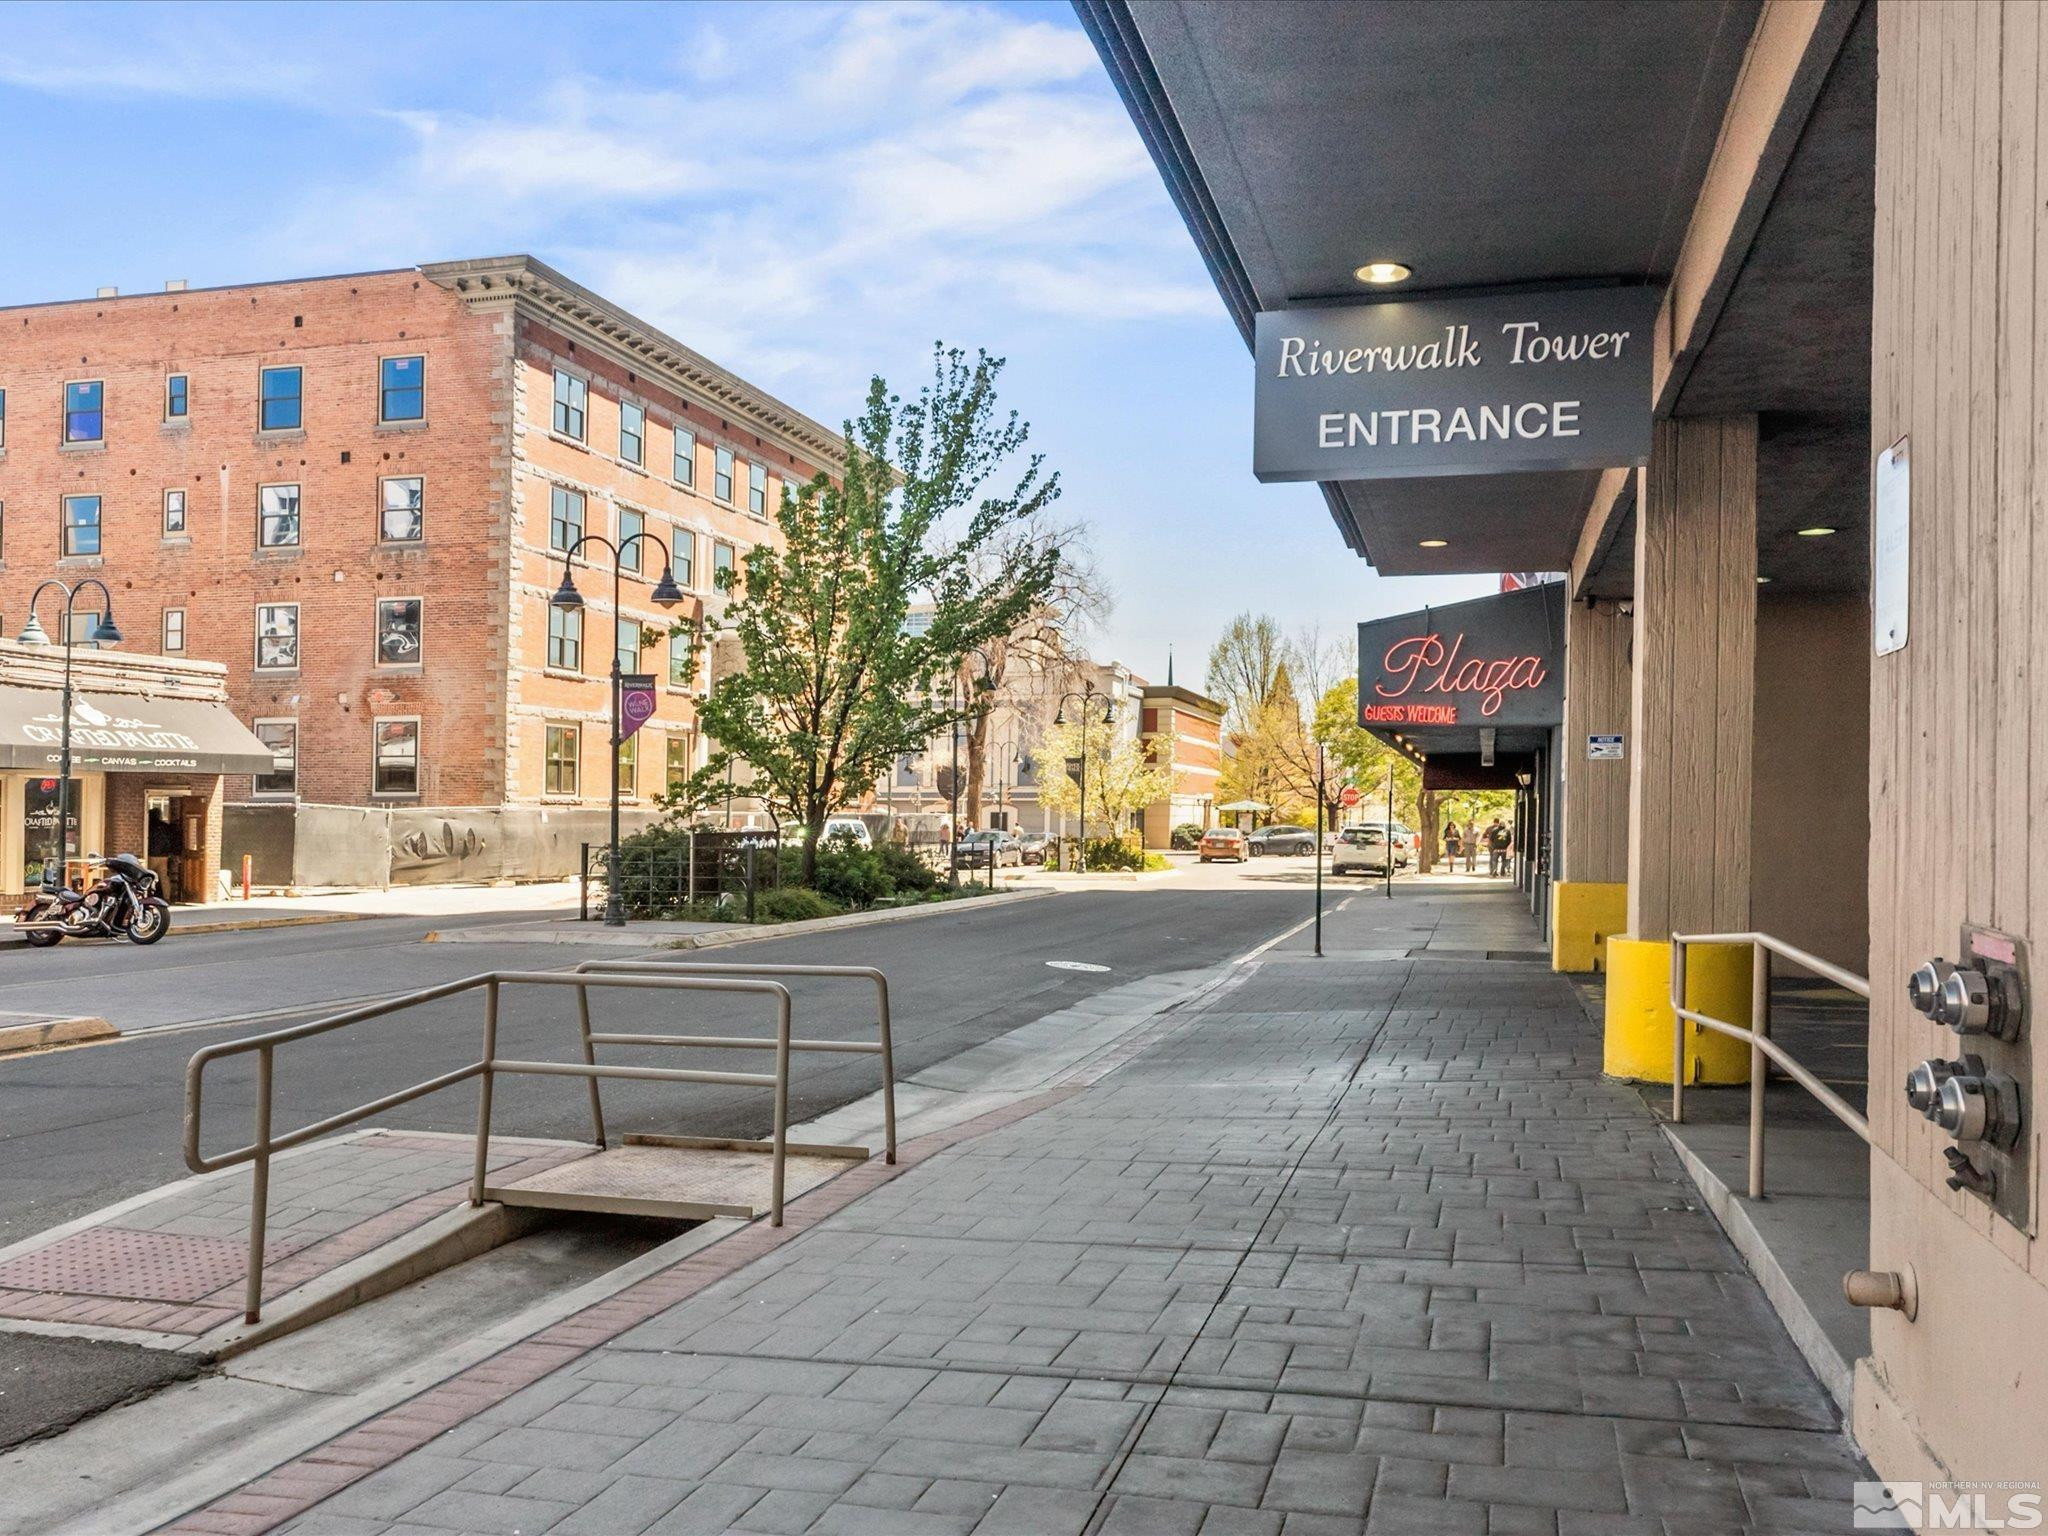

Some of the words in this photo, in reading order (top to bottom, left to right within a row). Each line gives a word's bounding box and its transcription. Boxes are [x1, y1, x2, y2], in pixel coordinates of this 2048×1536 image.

[1277, 325, 1481, 378] Riverwalk
[1502, 322, 1631, 365] Tower
[1319, 401, 1581, 448] ENTRANCE
[1375, 633, 1547, 716] Plaza
[1365, 705, 1404, 721] GUESTS
[1407, 705, 1456, 724] WELCOME
[47, 754, 81, 764] COEE
[101, 757, 137, 765] CANVAS
[154, 759, 197, 767] COCKTAILS
[53, 817, 77, 826] PATTE
